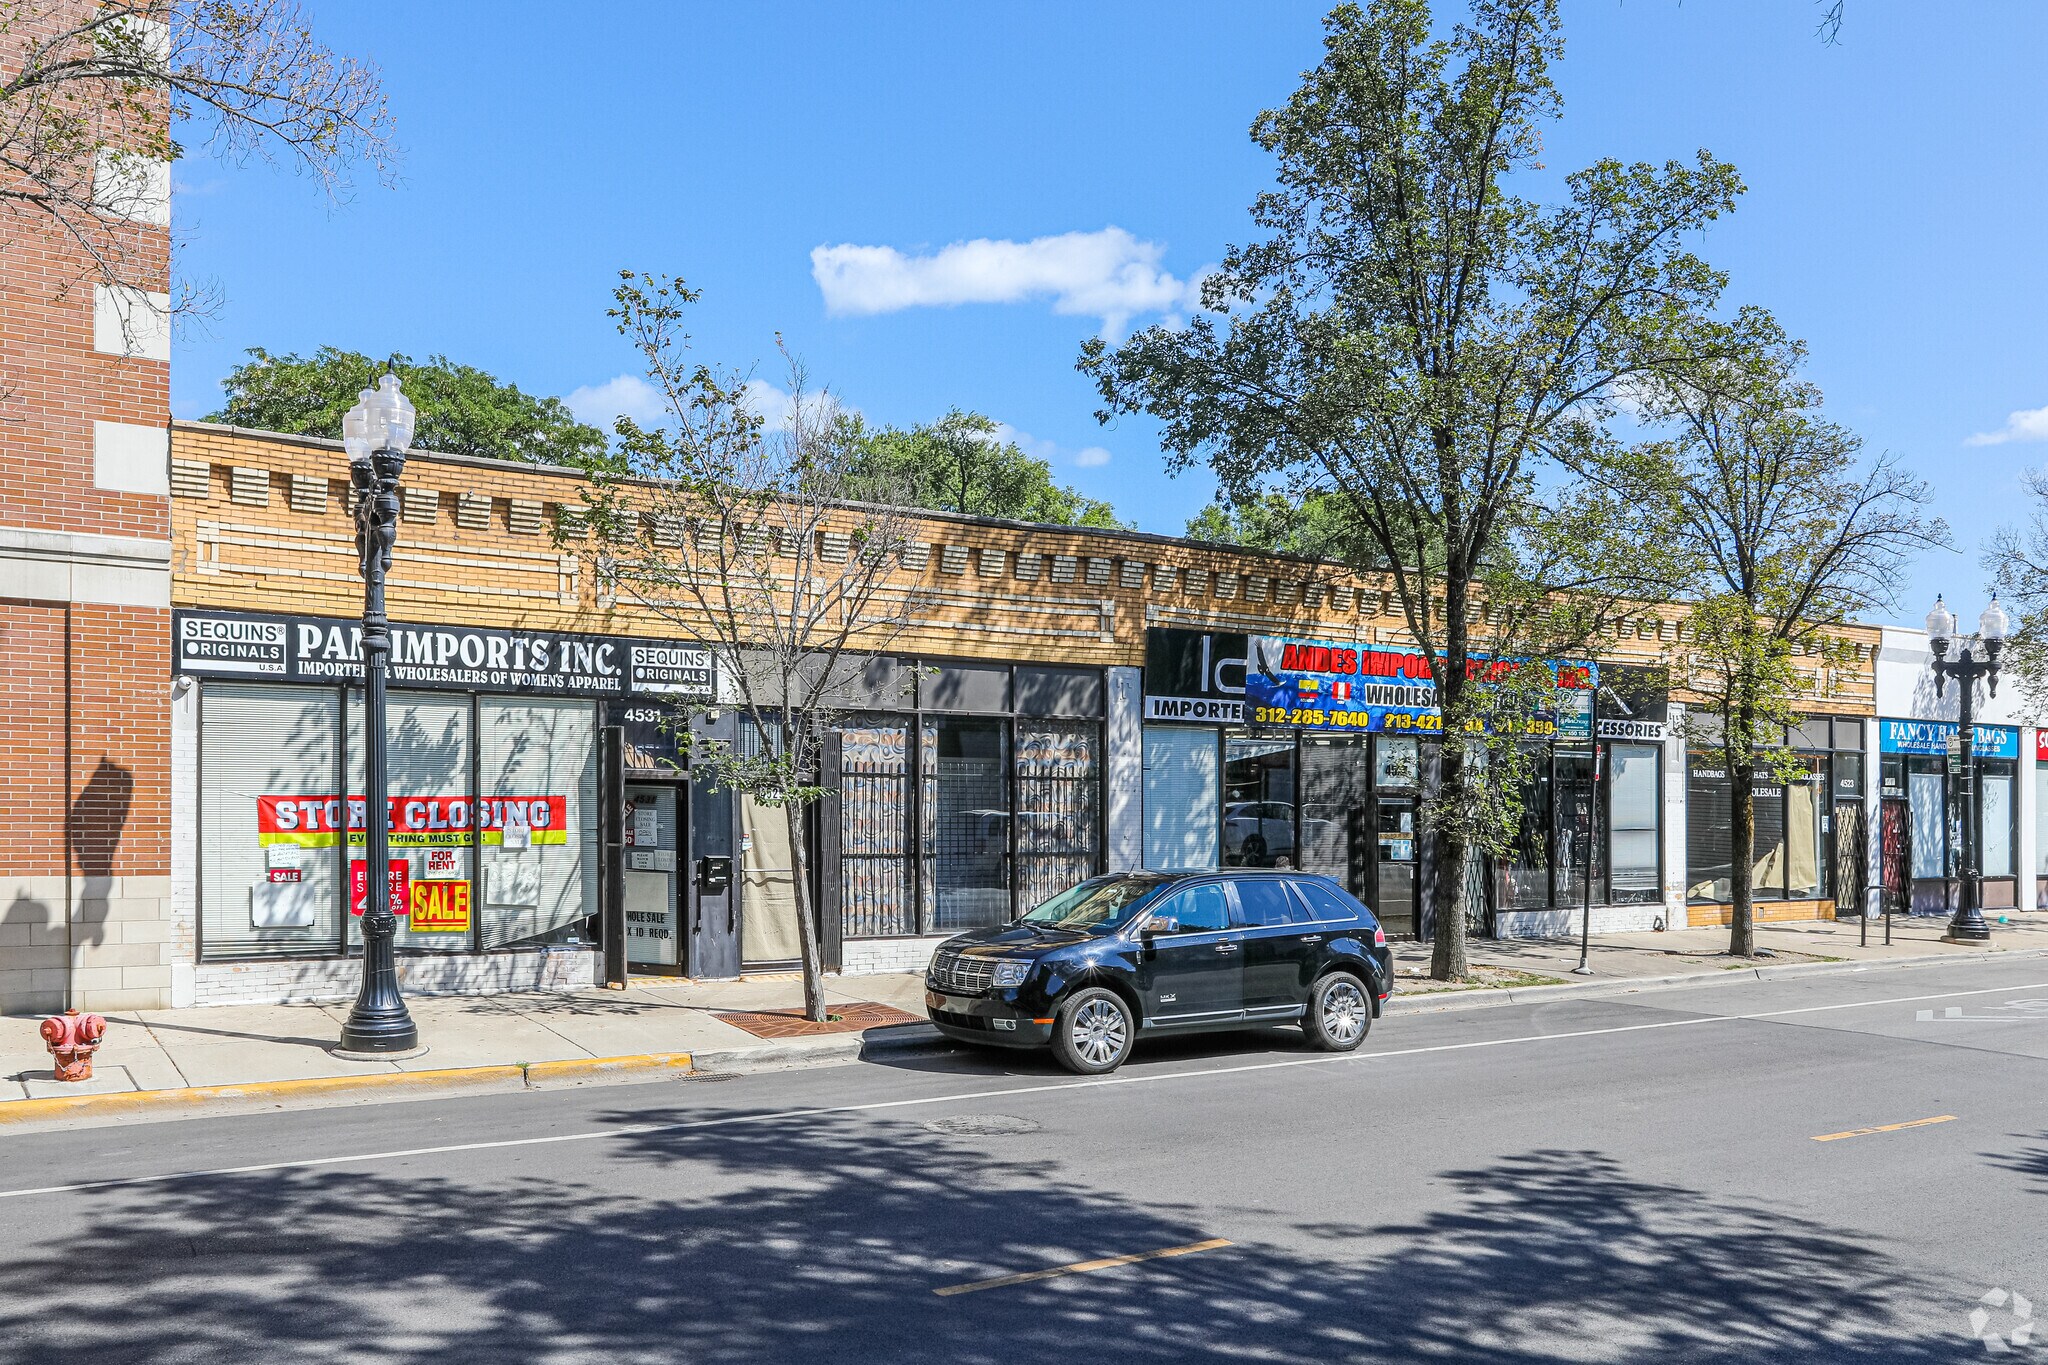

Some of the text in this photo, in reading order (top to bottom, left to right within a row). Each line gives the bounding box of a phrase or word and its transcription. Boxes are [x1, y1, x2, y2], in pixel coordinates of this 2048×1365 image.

[390, 630, 550, 671] IMPORTS
[559, 641, 622, 676] INC.
[1280, 643, 1358, 675] ANDES
[259, 664, 285, 672] U.S.A.
[298, 661, 365, 677] IMPORTE
[394, 666, 488, 684] WHOLESALERS
[491, 672, 507, 684] OF
[510, 672, 564, 688] WOMEN'S
[567, 676, 621, 691] APPAREL
[1366, 684, 1441, 708] WHOLESA
[624, 708, 661, 722] 4531
[1154, 700, 1245, 718] IMPORTE
[1255, 707, 1369, 727] 312-285-7640
[1889, 722, 1935, 742] FANCY
[1977, 727, 2008, 745] BAGS
[1897, 740, 1930, 750] WHOLESALE
[1693, 769, 1725, 778] HANDBAGS
[1753, 771, 1769, 779] HATS
[1840, 779, 1855, 788] 4523
[1752, 788, 1782, 797] OLESALE
[405, 801, 550, 828] CLOSING
[349, 834, 424, 843] EVTHING
[429, 834, 459, 843] MUST
[431, 851, 453, 860] FOR
[428, 861, 456, 870] RENT
[274, 872, 298, 881] SALE
[415, 885, 467, 920] SALE
